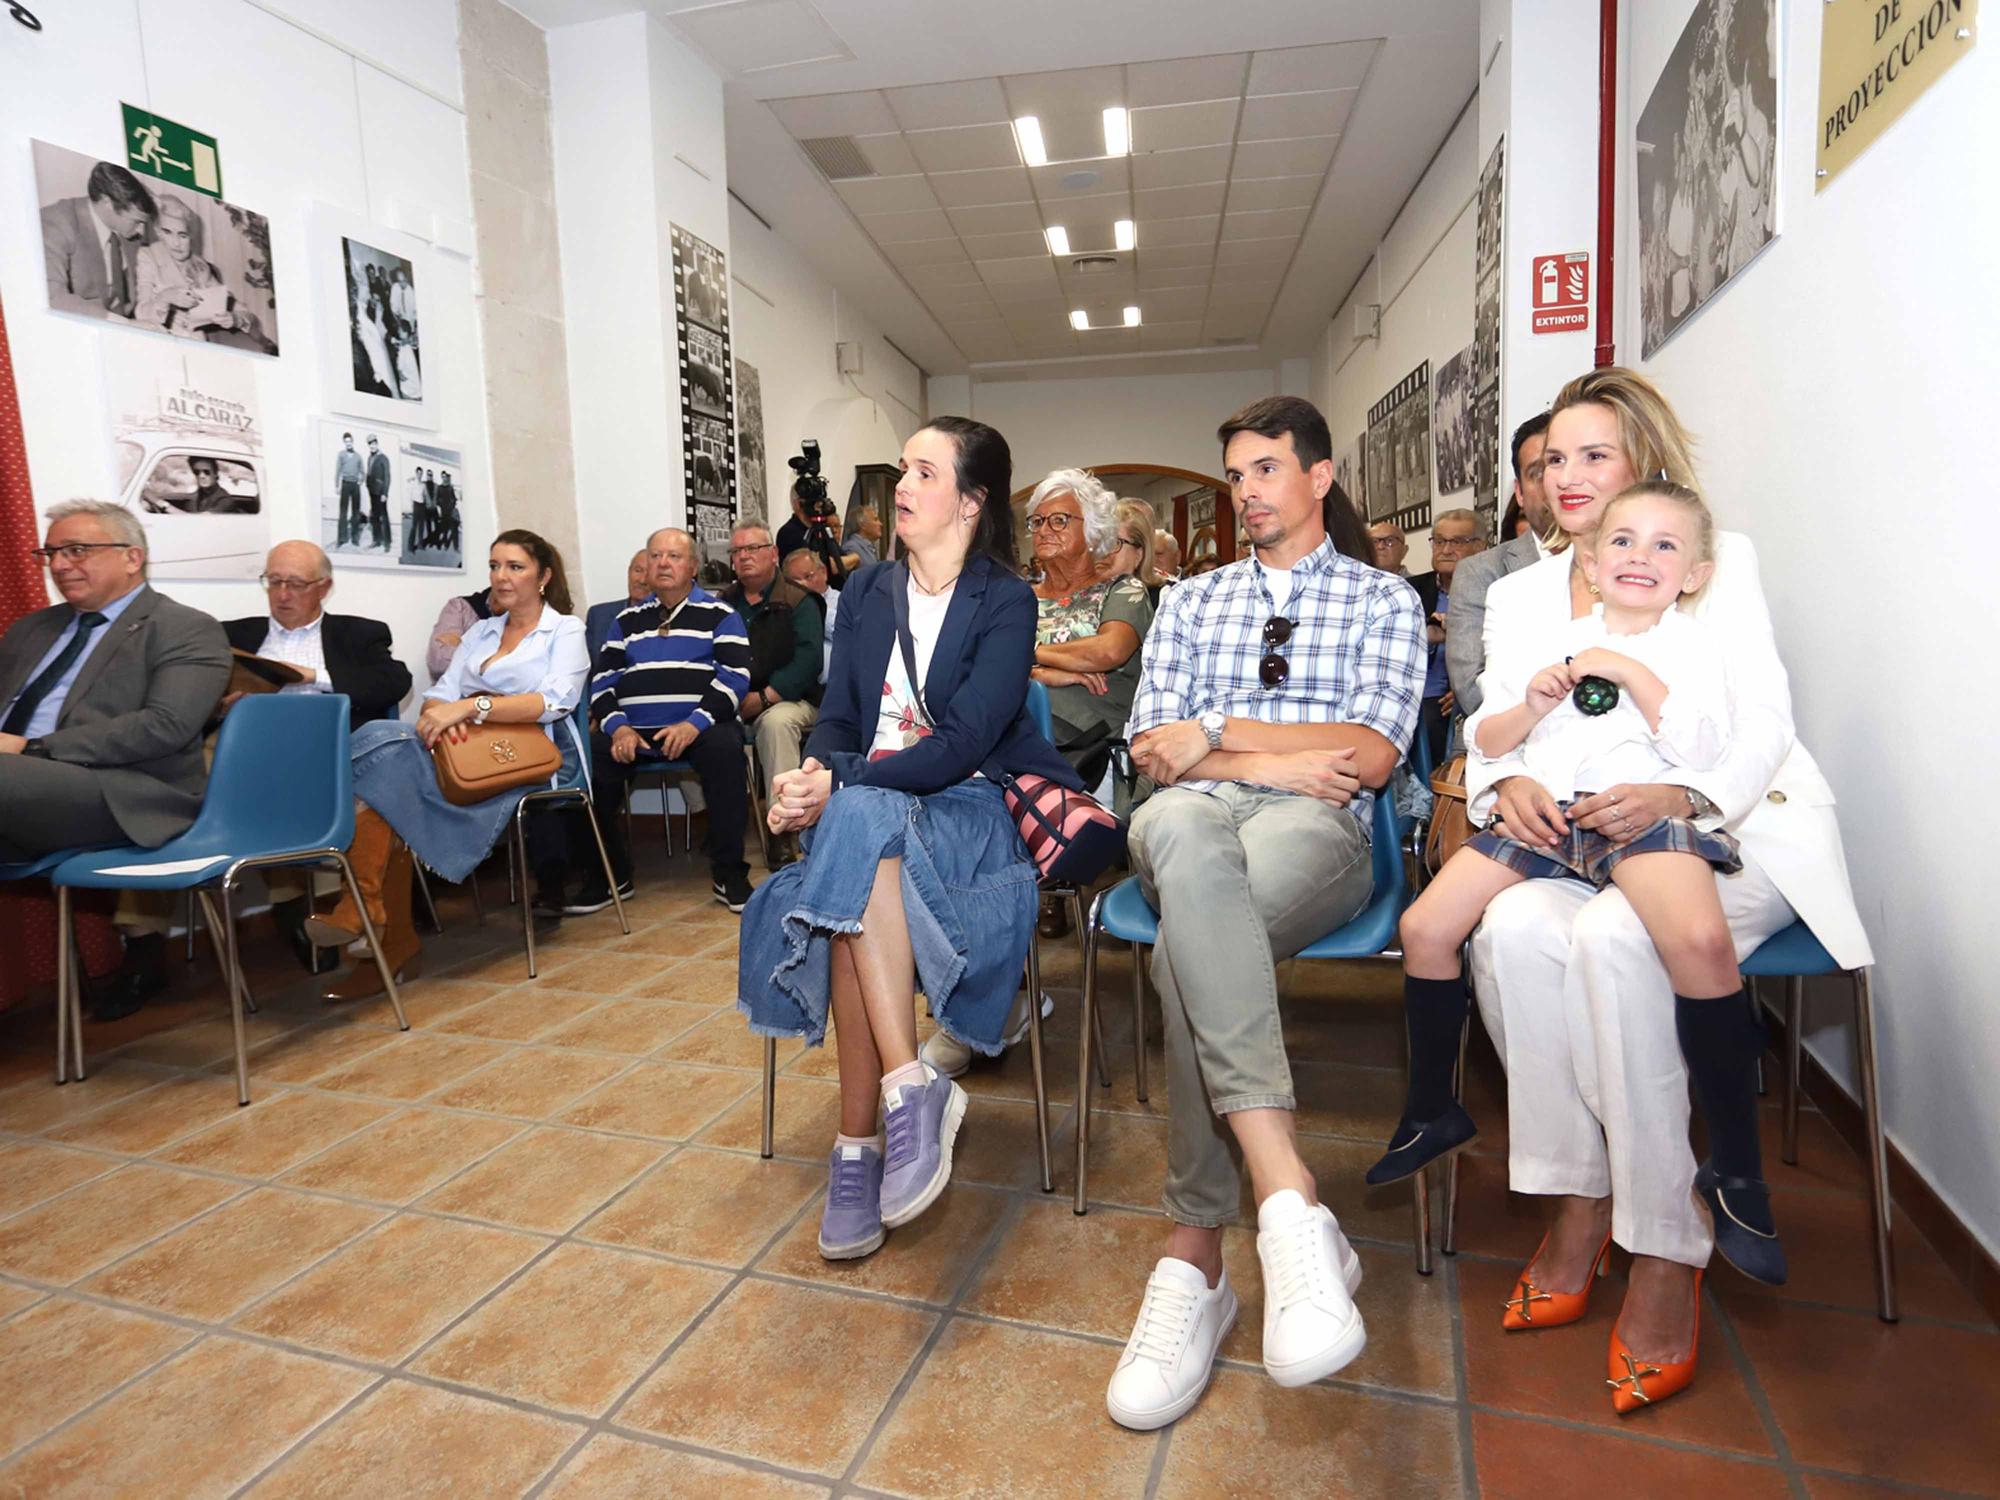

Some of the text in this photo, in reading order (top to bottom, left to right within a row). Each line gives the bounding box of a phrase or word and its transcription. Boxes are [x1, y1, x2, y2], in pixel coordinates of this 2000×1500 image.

[1874, 0, 1901, 45] DE
[1536, 314, 1585, 326] EXTINTOR
[168, 397, 253, 429] ALCARAZ
